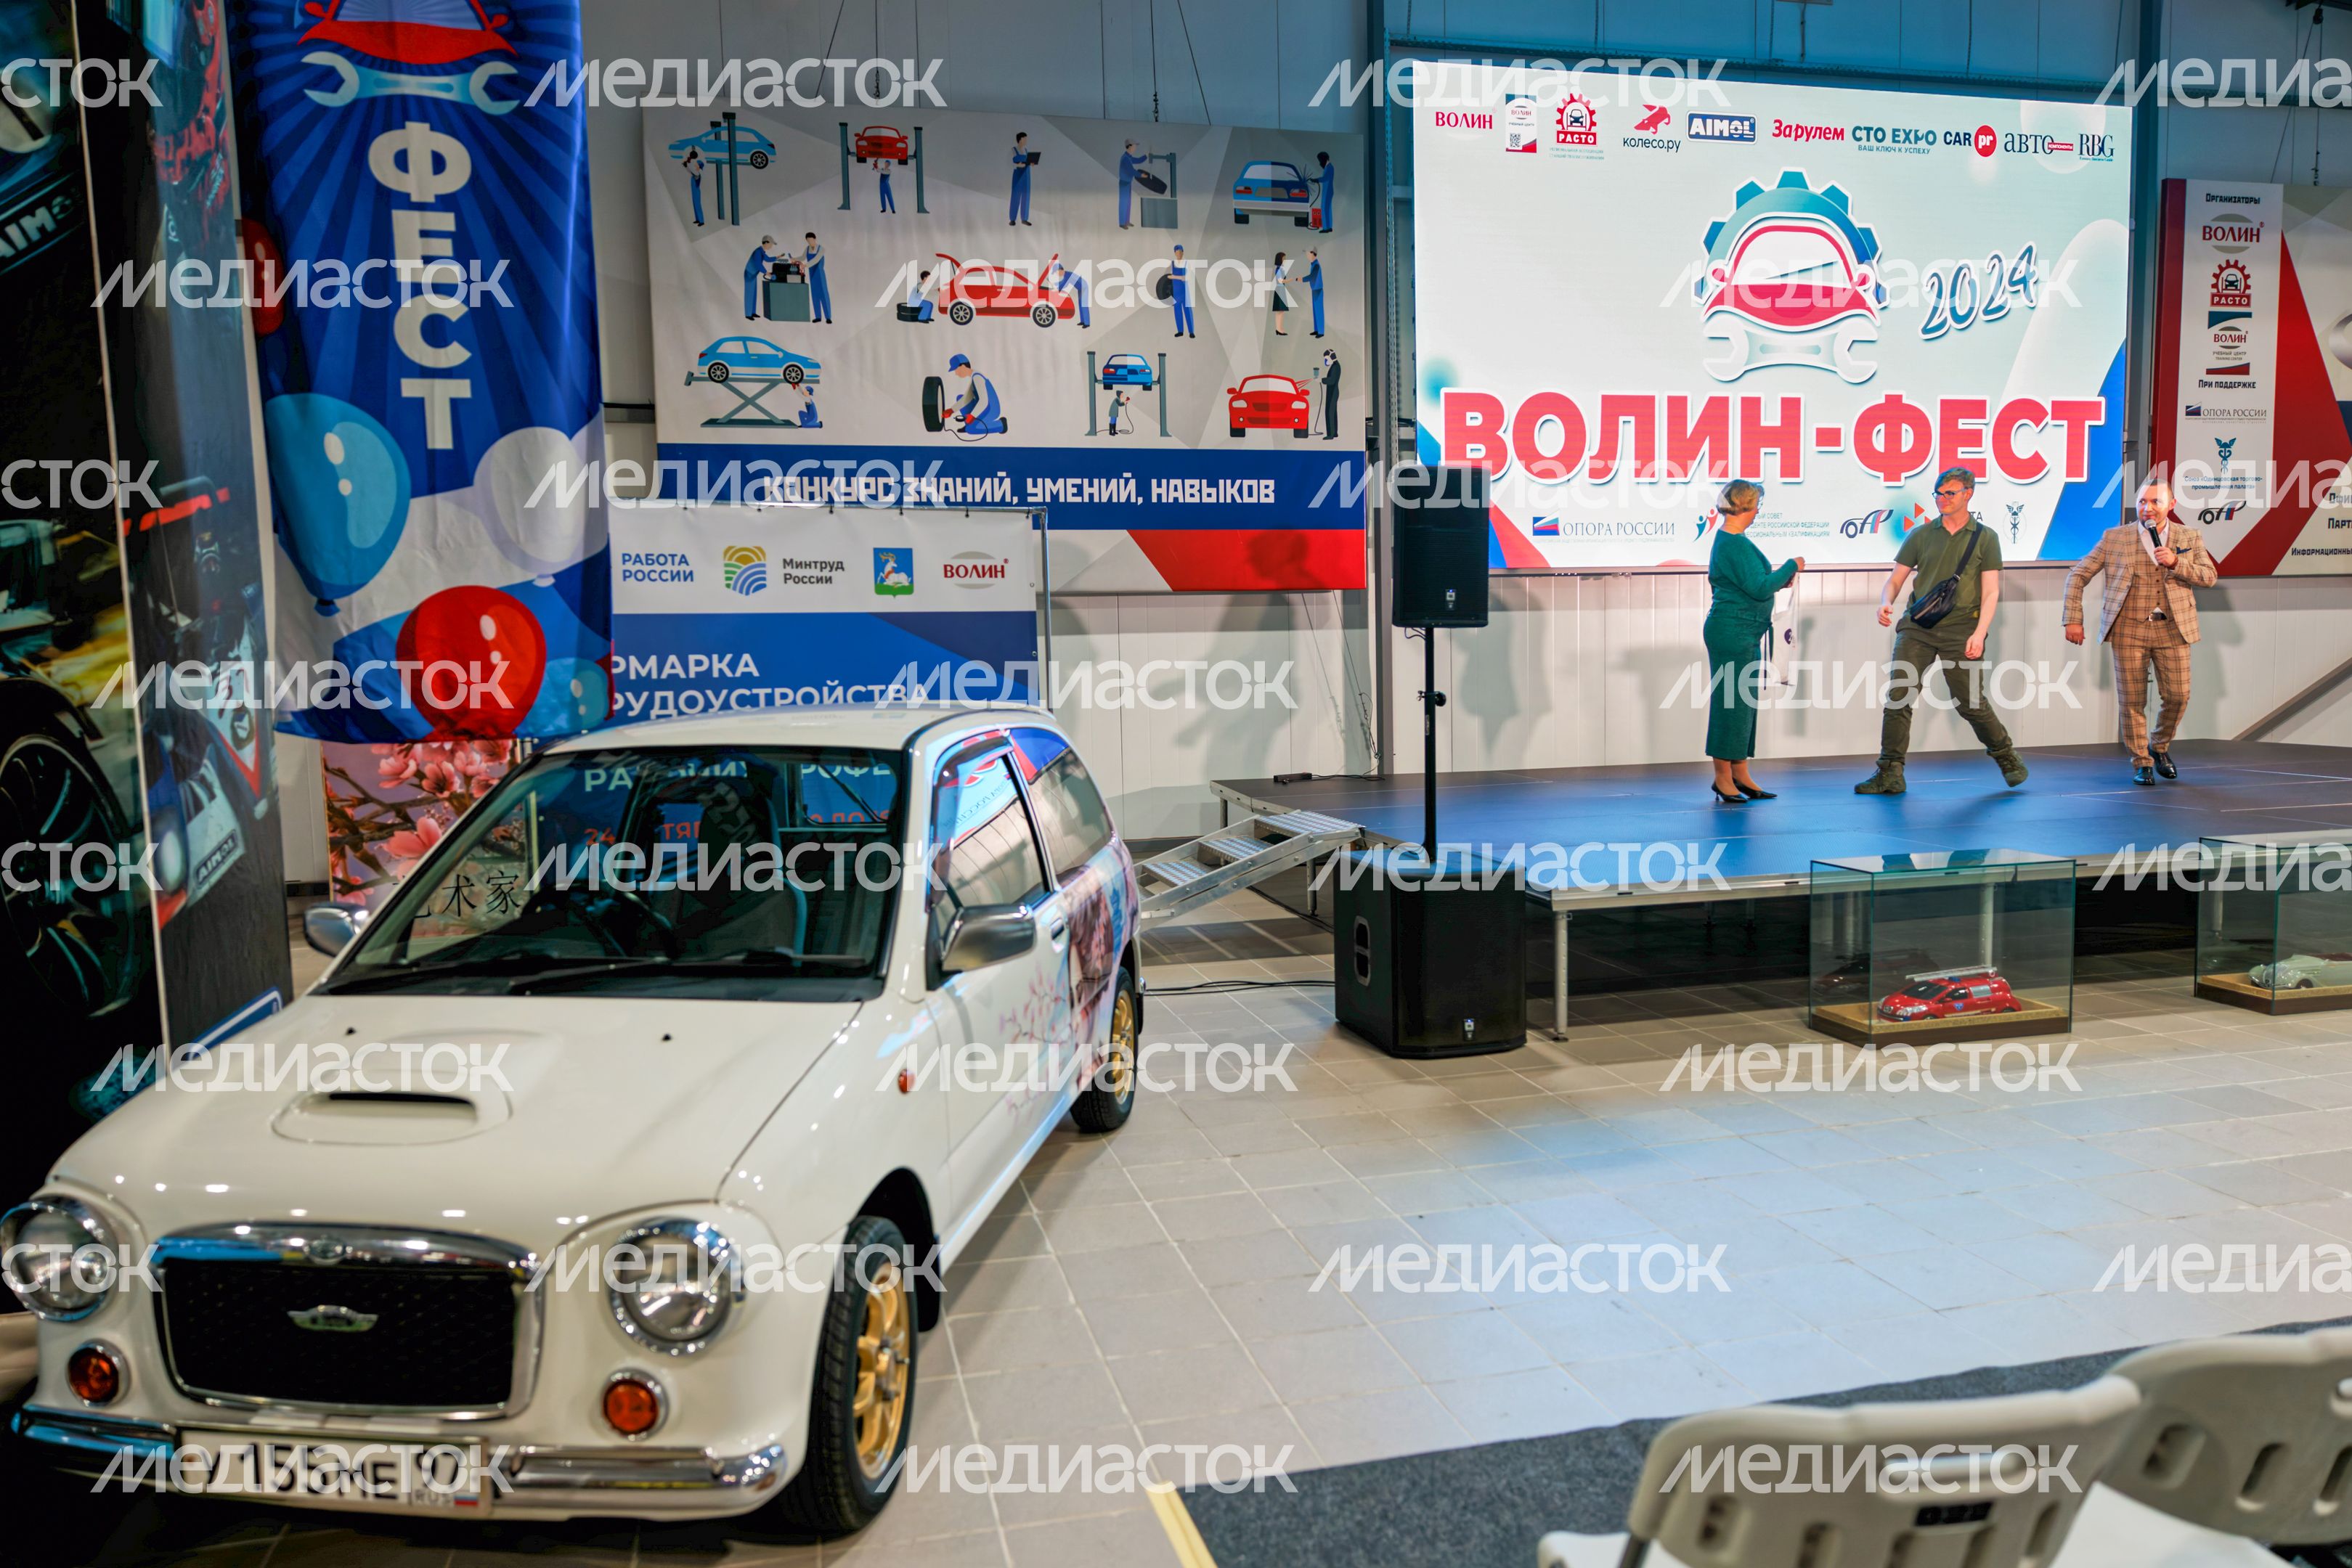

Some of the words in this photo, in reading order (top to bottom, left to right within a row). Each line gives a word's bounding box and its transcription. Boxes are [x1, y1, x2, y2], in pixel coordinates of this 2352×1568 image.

[1436, 111, 1493, 129] ВОЛИН
[1690, 117, 1754, 139] AIMOL
[1558, 133, 1595, 144] РАСТО
[1852, 126, 1886, 143] СТО
[1943, 131, 1971, 146] CAR
[1623, 136, 1681, 153] колесо.ру
[2202, 225, 2261, 242] ВОЛИН
[368, 121, 471, 450] ФЕСТ
[1919, 241, 2038, 339] 2024
[2213, 295, 2249, 305] РАСТО
[2213, 333, 2247, 343] ВОЛИН
[764, 476, 895, 503] КОНКУРС
[903, 471, 1018, 505] ЗНАНИЙ,
[1028, 473, 1143, 506] УМЕНИЙ,
[1152, 479, 1275, 503] НАВЫКОВ
[1563, 522, 1612, 536] ОПОРА
[1616, 522, 1675, 536] РОССИИ
[622, 553, 689, 566] РАБОТА
[783, 558, 845, 572] Минтруд
[622, 569, 694, 582] РОССИИ
[784, 573, 833, 585] России
[943, 563, 1005, 579] ВОЛИН
[611, 653, 760, 679] РМАРКА
[611, 679, 929, 720] РУДОУСТРОЙСТВА
